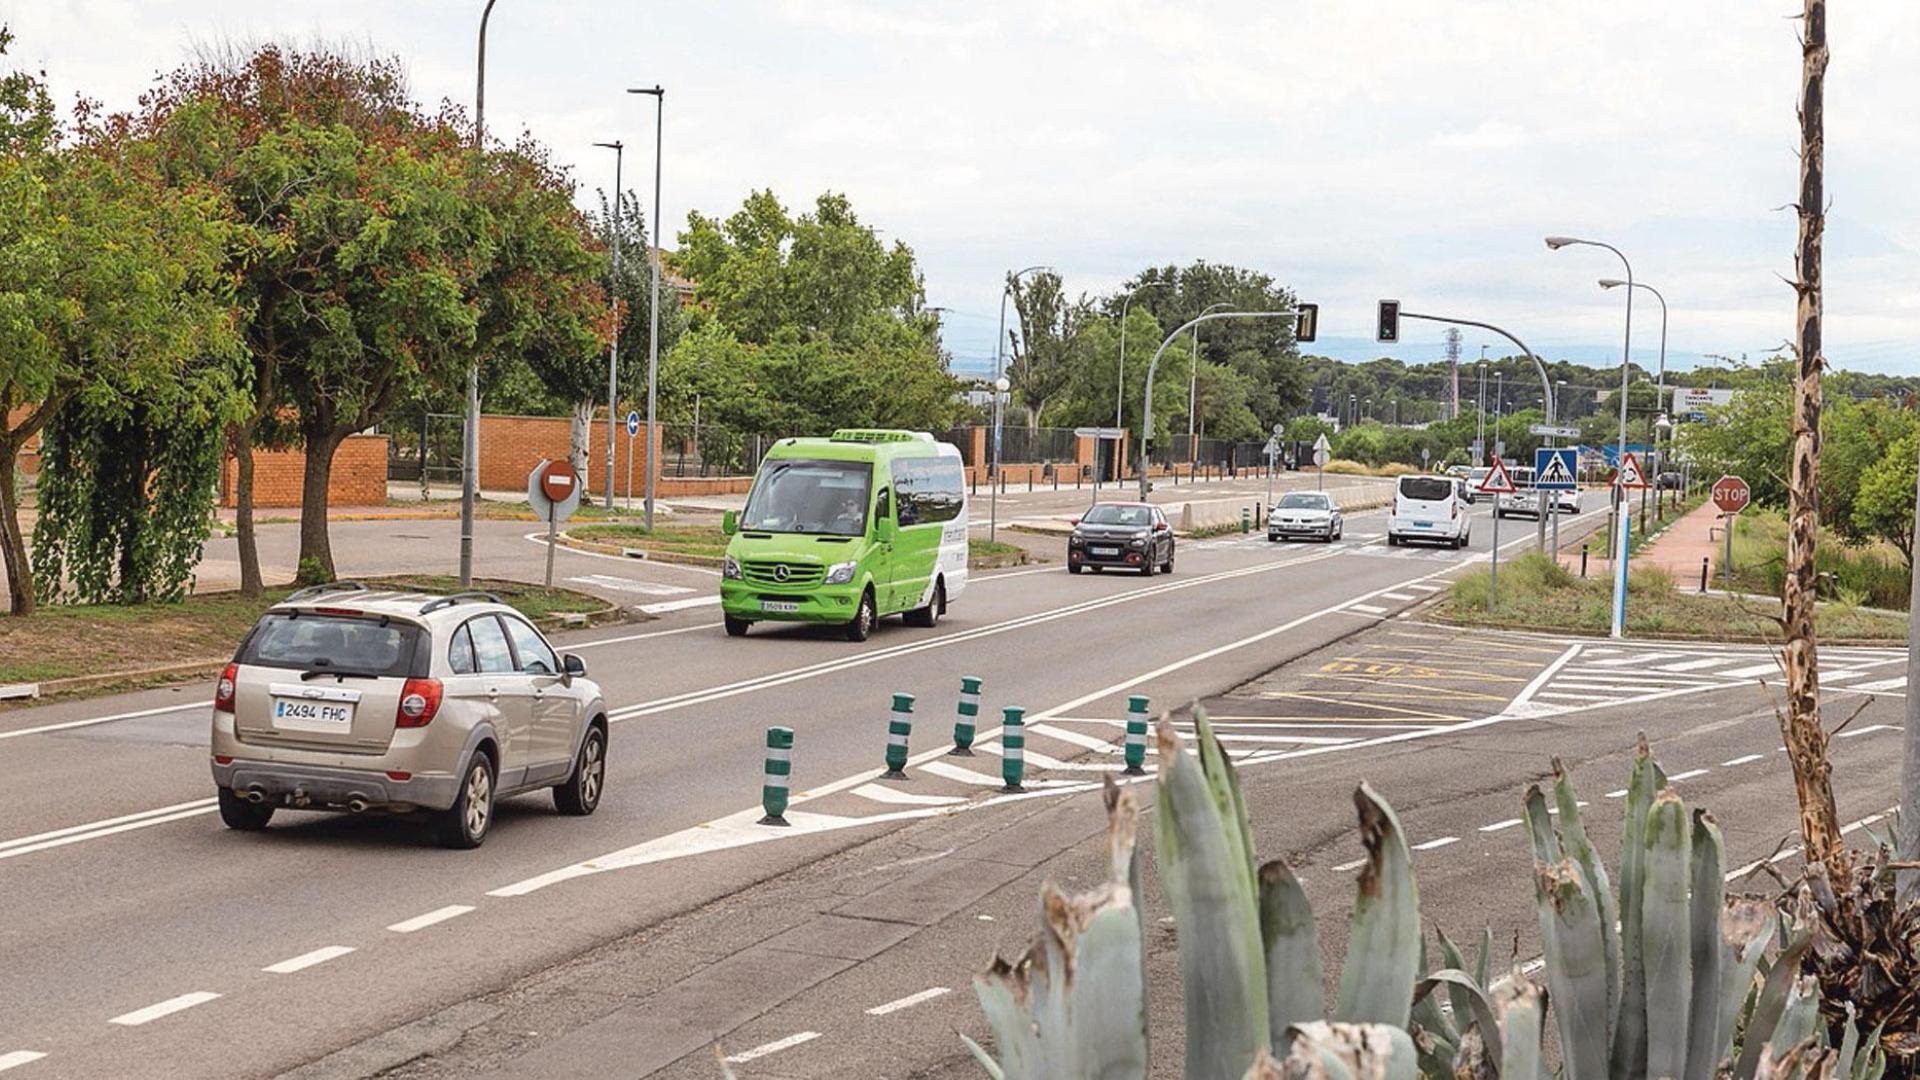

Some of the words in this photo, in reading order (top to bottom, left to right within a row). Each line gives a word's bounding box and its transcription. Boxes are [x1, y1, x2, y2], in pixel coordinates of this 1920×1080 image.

[1715, 487, 1748, 502] STOP
[285, 703, 316, 718] 2494
[321, 706, 347, 721] FHC
